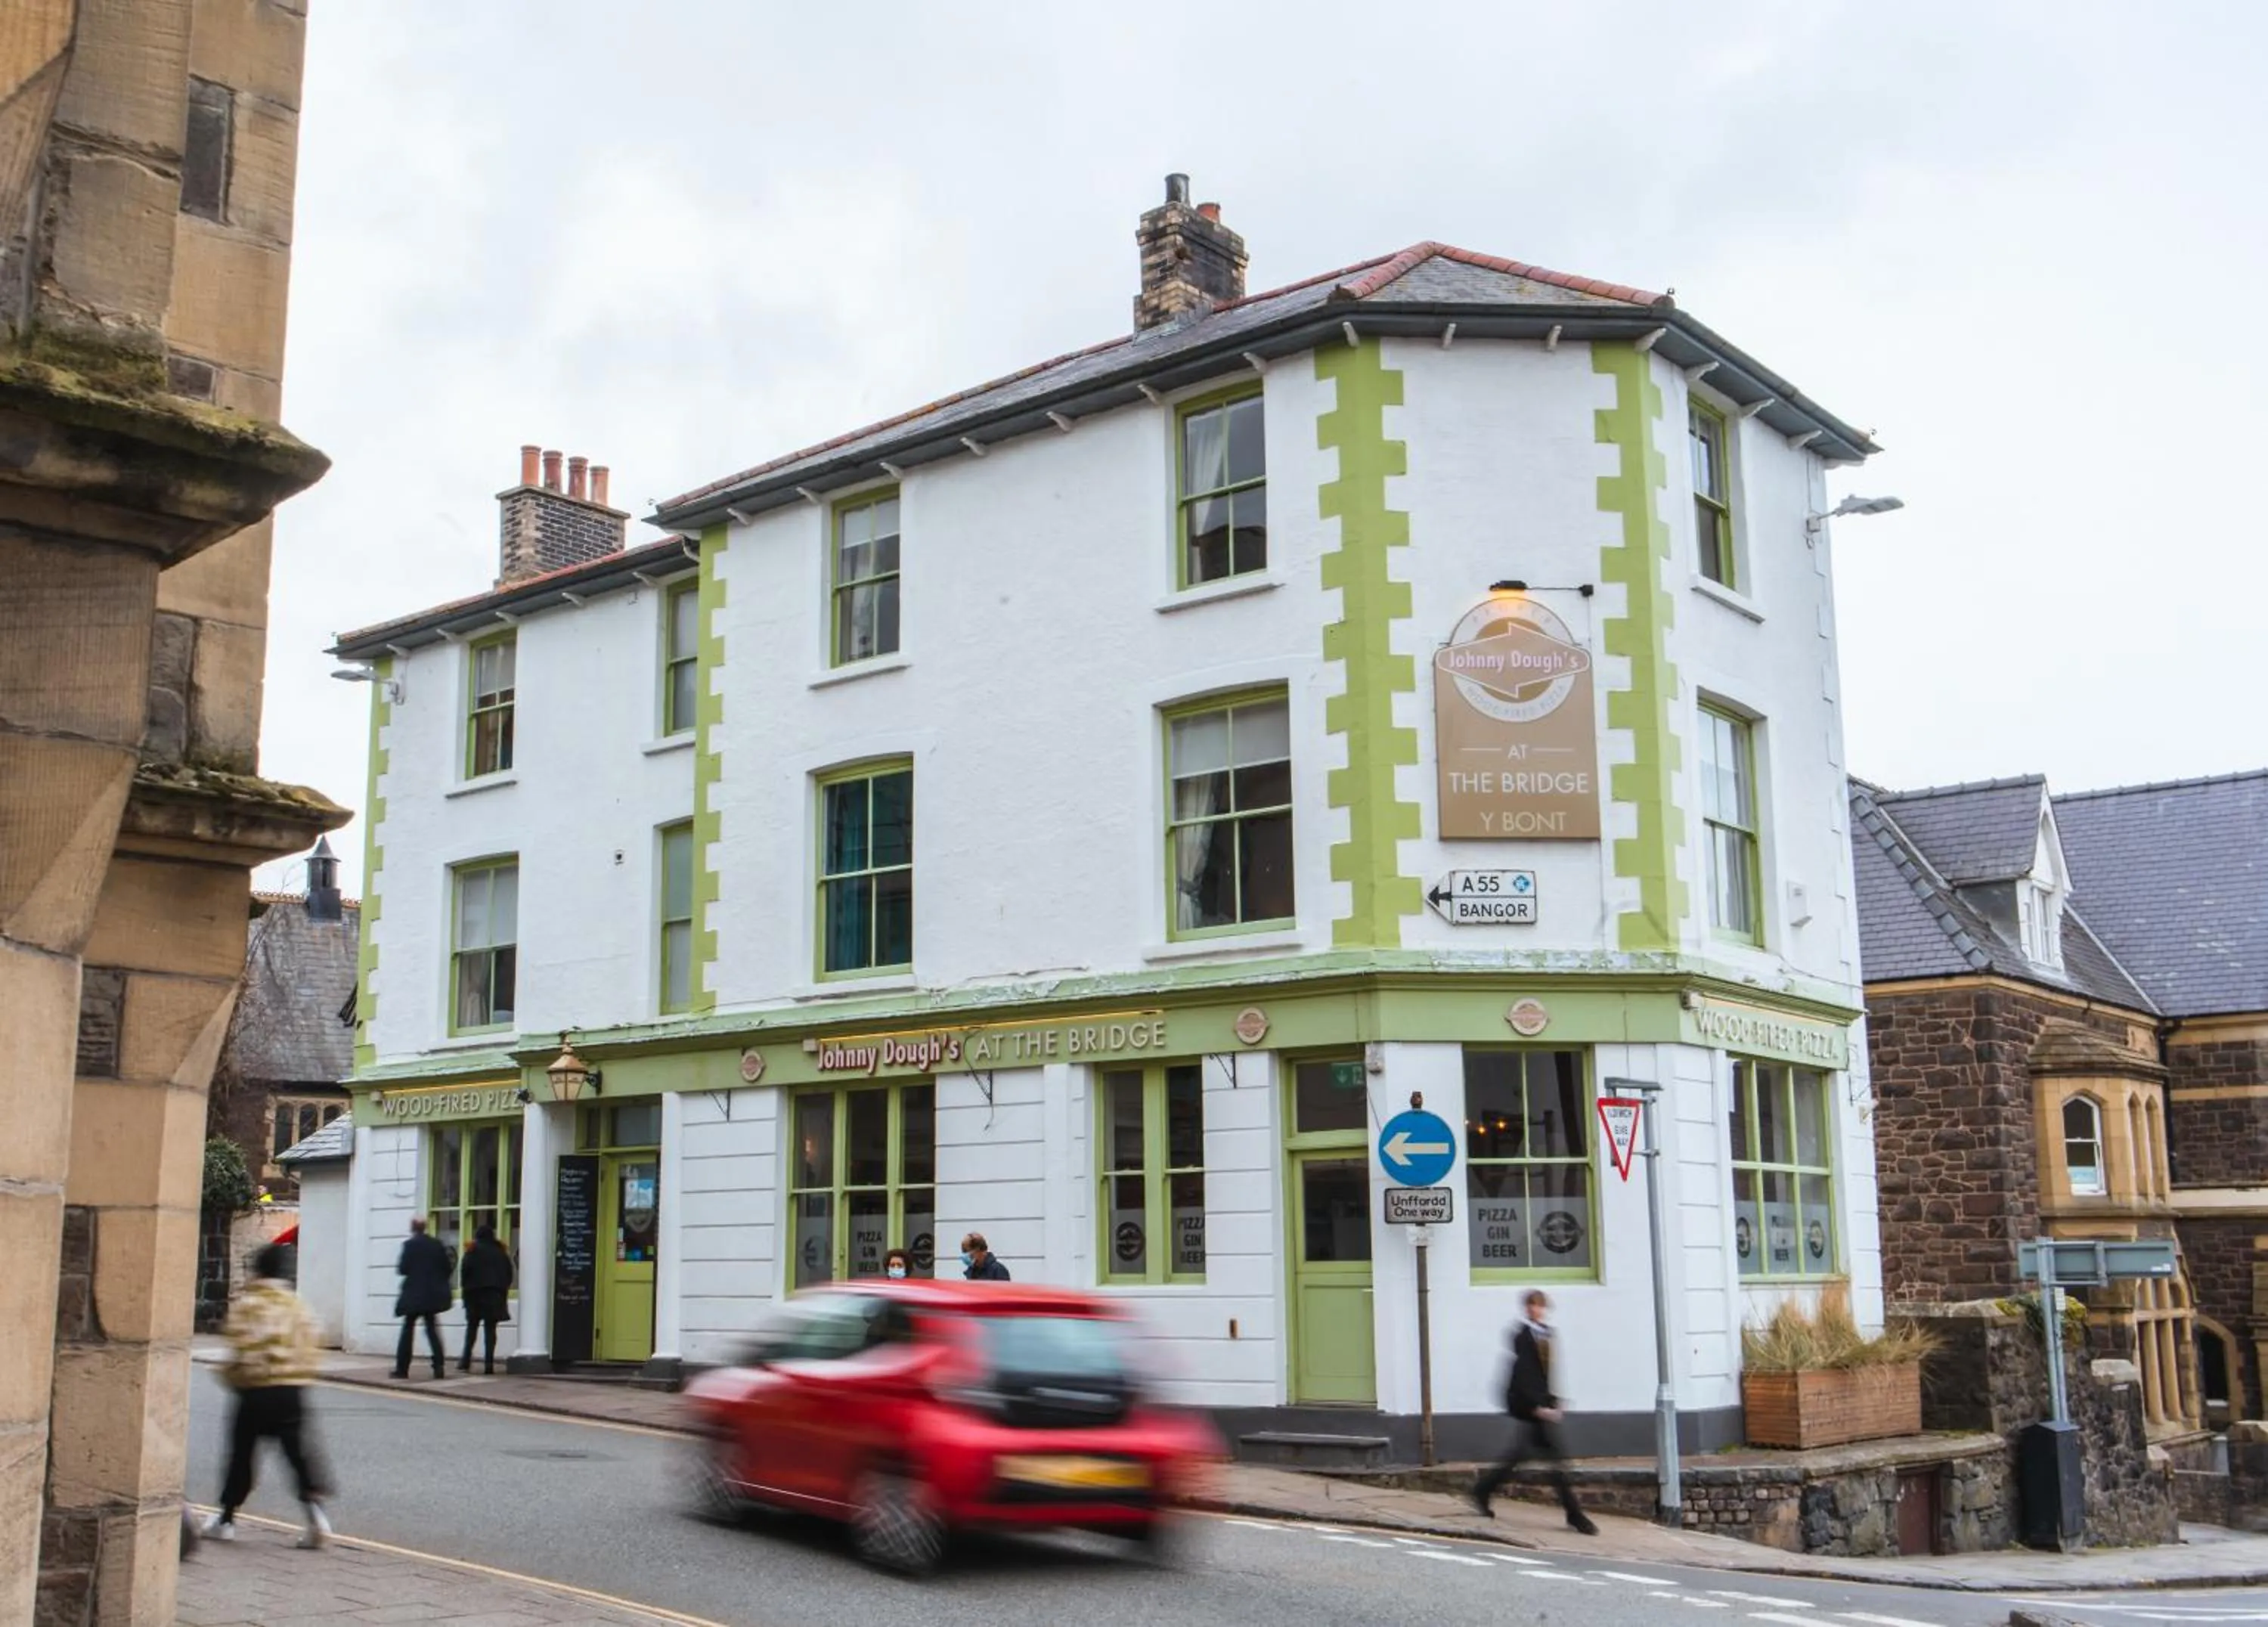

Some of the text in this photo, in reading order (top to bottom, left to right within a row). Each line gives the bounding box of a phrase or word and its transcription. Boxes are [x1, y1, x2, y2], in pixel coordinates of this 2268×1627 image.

[1449, 649, 1579, 673] Johnny Dough's
[1507, 744, 1529, 760] AT
[1448, 772, 1590, 794] THE BRIDGE
[1479, 811, 1567, 832] Y BONT
[1460, 903, 1529, 918] BANGOR
[818, 1020, 1167, 1075] Johnny Dough's AT THE BRIDGE
[382, 1088, 525, 1117] WOOD-FIRED PIZZ
[1391, 1195, 1446, 1207] Unffordd
[1394, 1206, 1445, 1219] One way
[1478, 1208, 1517, 1223] PIZZA
[857, 1231, 883, 1244] PIZZA
[1183, 1233, 1201, 1247] GIN
[1487, 1226, 1510, 1240] GIN
[1483, 1244, 1517, 1258] BEER
